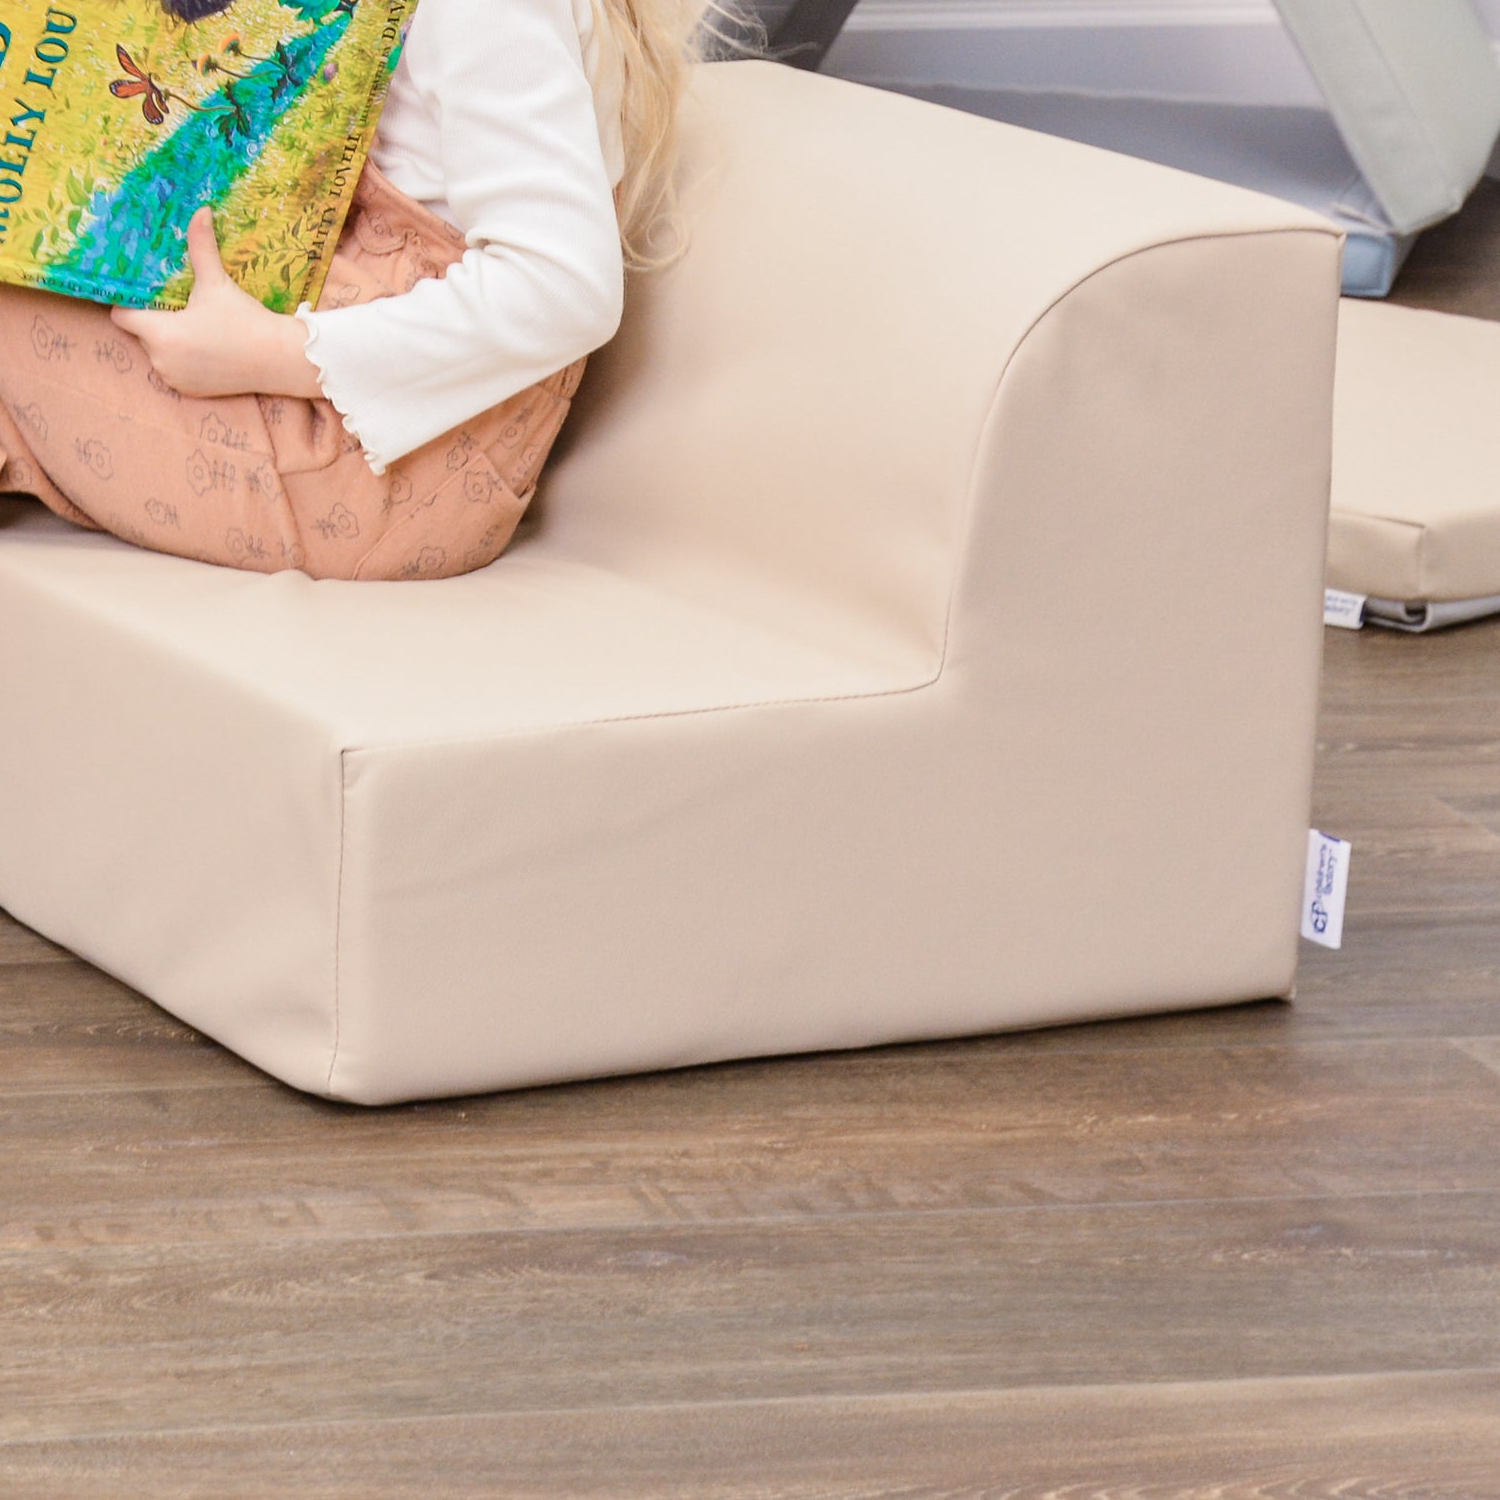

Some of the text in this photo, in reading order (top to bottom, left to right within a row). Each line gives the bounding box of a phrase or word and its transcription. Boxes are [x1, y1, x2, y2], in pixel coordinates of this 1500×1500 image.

[23, 6, 78, 91] LOU
[307, 203, 336, 261] PATTY
[329, 133, 361, 197] LOVELL
